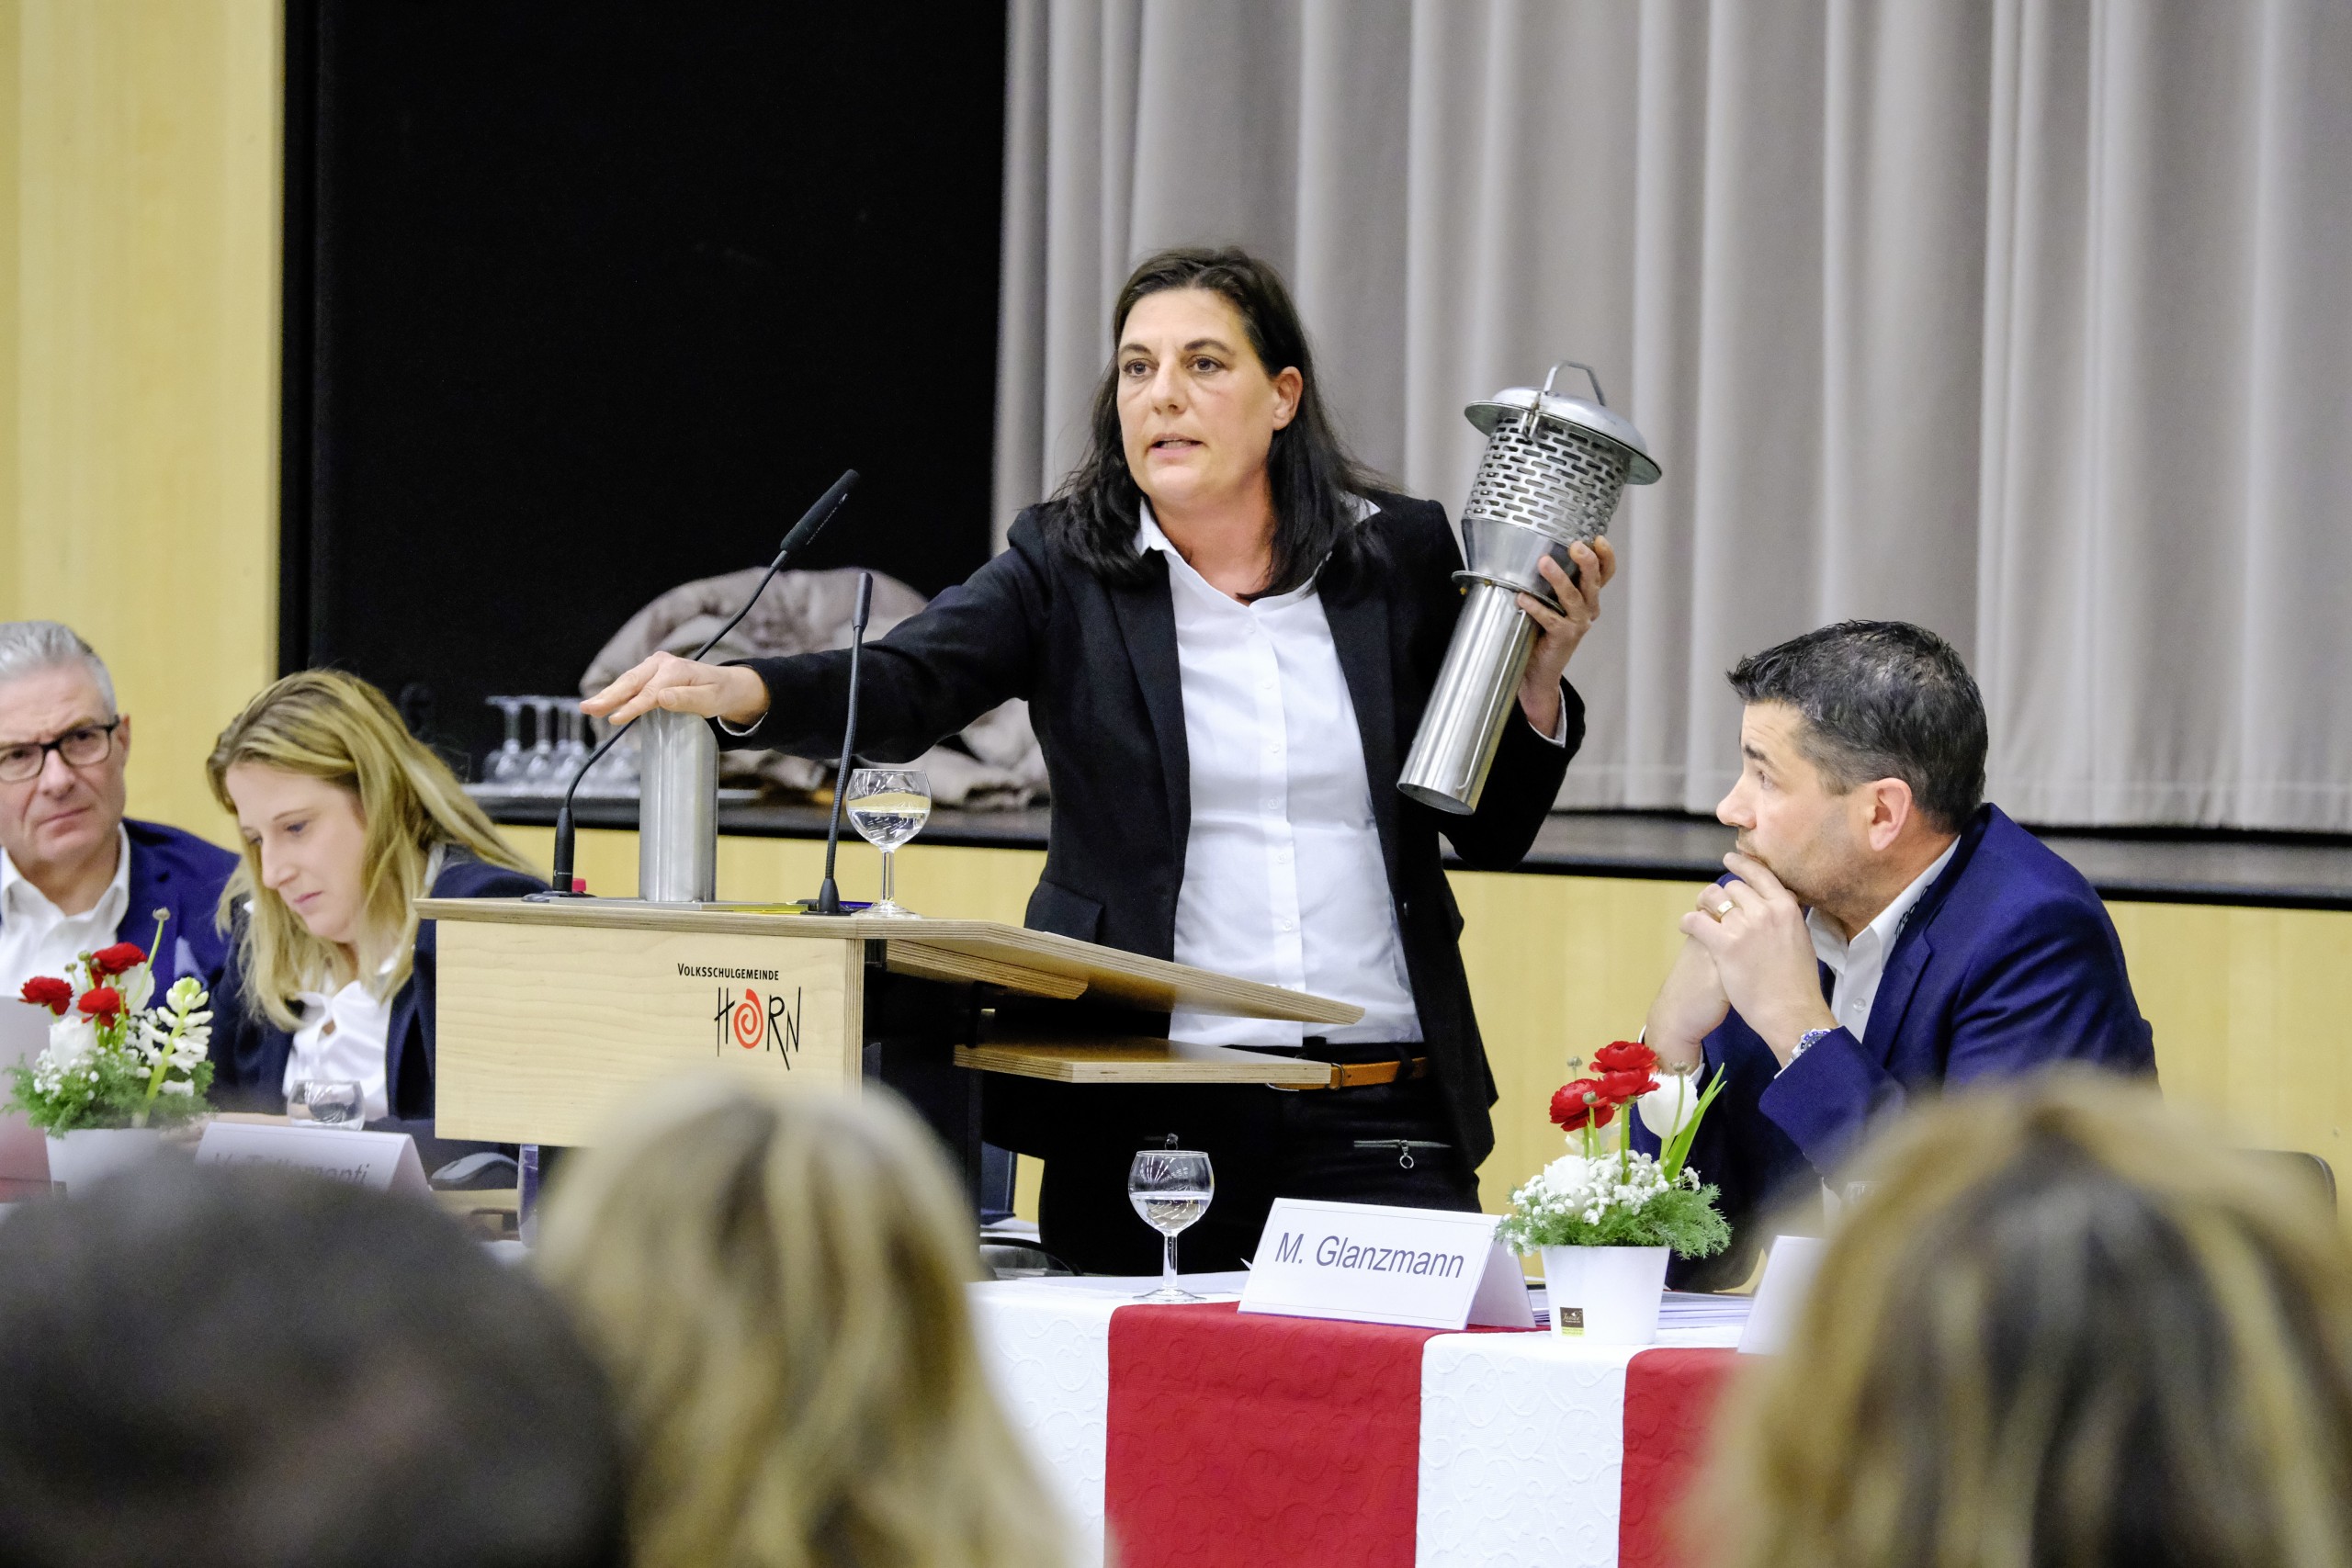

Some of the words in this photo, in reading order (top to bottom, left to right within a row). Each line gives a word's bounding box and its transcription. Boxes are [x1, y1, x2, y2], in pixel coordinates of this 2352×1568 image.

[677, 963, 779, 980] VOLKSSCHULGEMEINDE
[714, 987, 802, 1071] HORN
[1274, 1232, 1305, 1264] M.
[1316, 1235, 1465, 1279] Glanzmann
